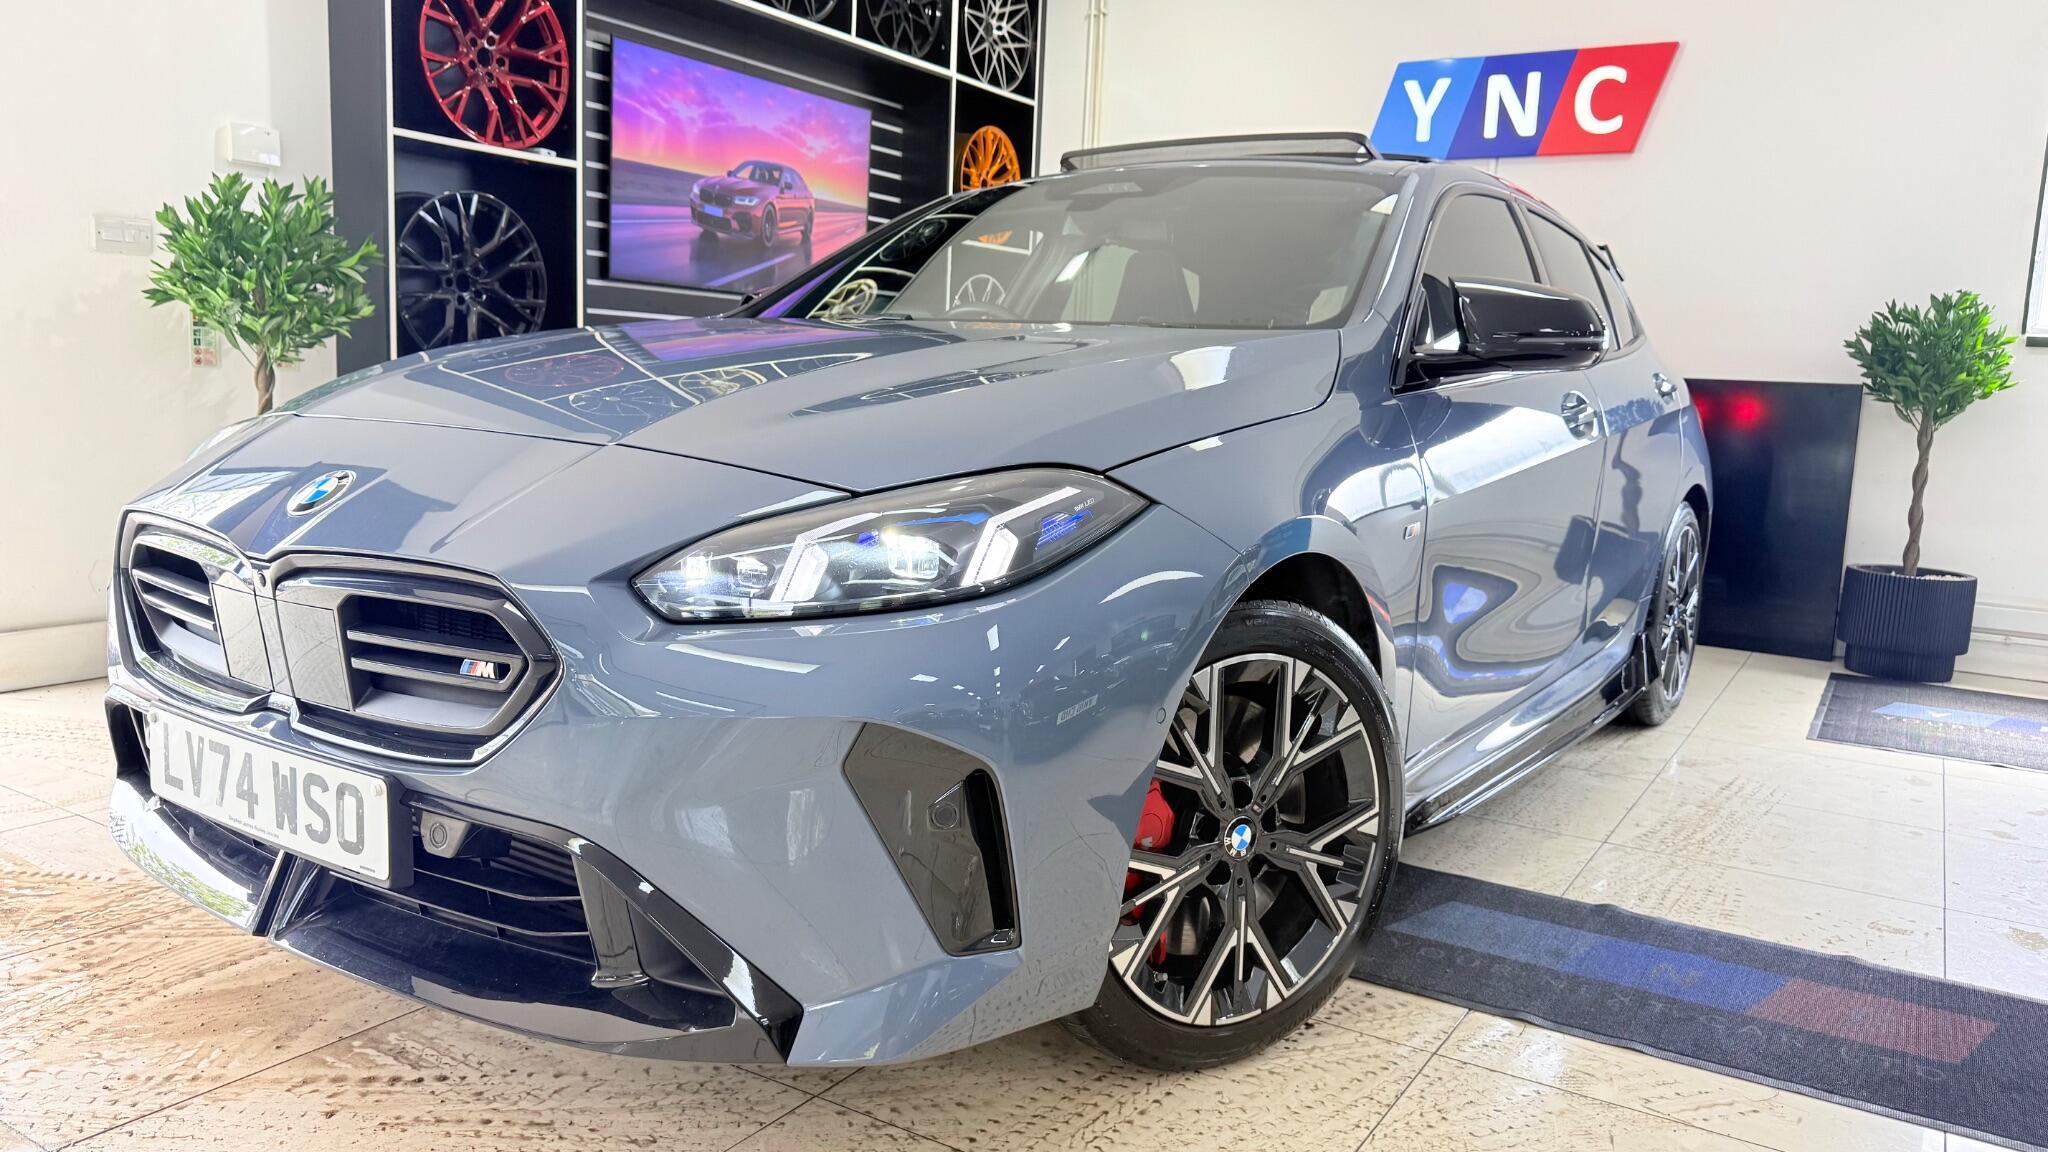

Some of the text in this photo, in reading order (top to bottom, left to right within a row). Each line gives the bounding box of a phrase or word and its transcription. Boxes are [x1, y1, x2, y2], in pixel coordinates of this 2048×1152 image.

[1404, 65, 1627, 142] YNC
[476, 661, 495, 679] M
[164, 723, 365, 856] LV74 WSO
